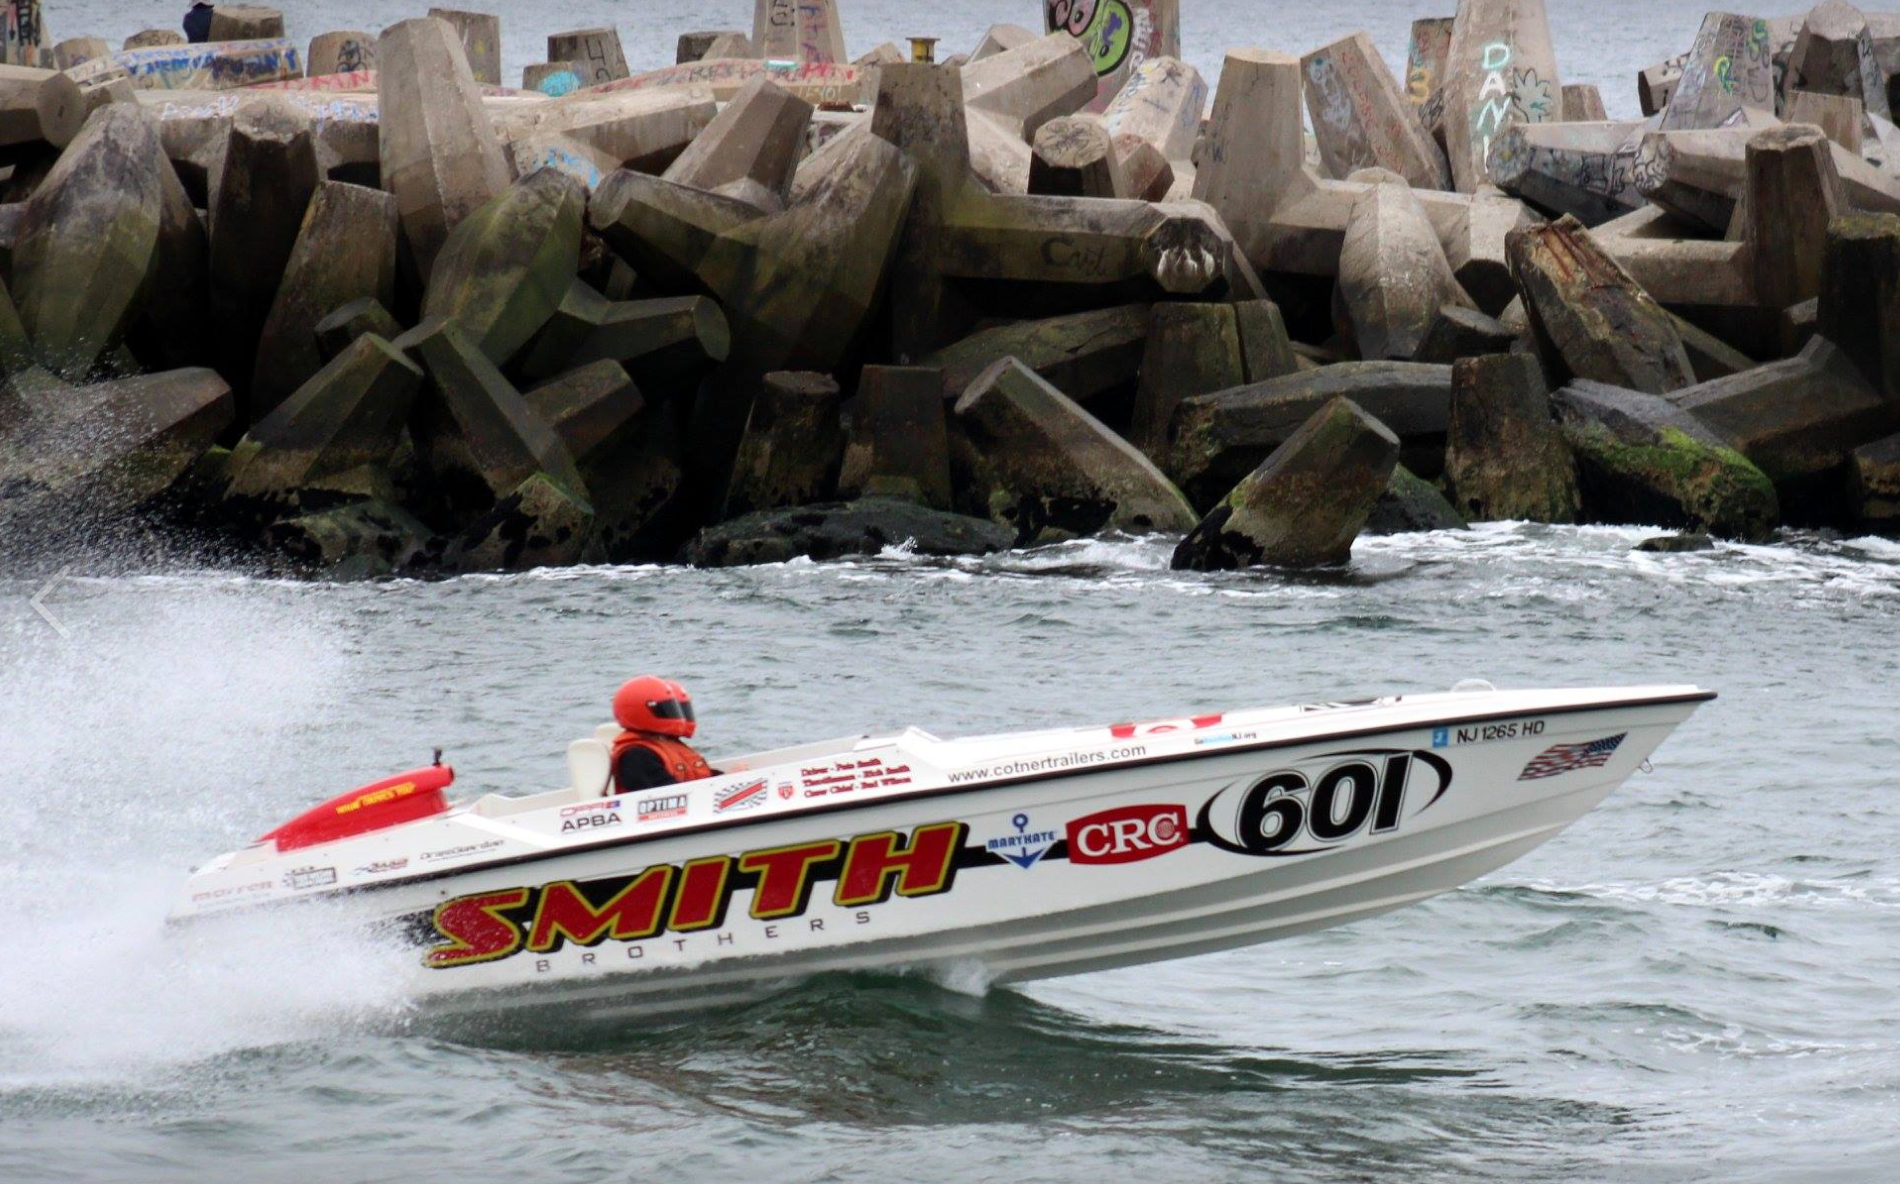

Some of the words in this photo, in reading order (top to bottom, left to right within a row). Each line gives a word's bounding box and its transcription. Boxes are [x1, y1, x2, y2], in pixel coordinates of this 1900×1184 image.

[1476, 43, 1511, 174] DANI
[1457, 727, 1478, 743] NJ
[1482, 723, 1518, 740] 1265
[1522, 721, 1545, 736] HD
[947, 744, 1147, 783] www.cotnertrailers.com
[561, 812, 622, 833] APBA
[638, 794, 688, 815] OPTIMA
[1235, 751, 1413, 851] 601
[1077, 811, 1182, 857] CRC
[422, 820, 968, 969] SMITH
[536, 911, 871, 973] BROTHERS
